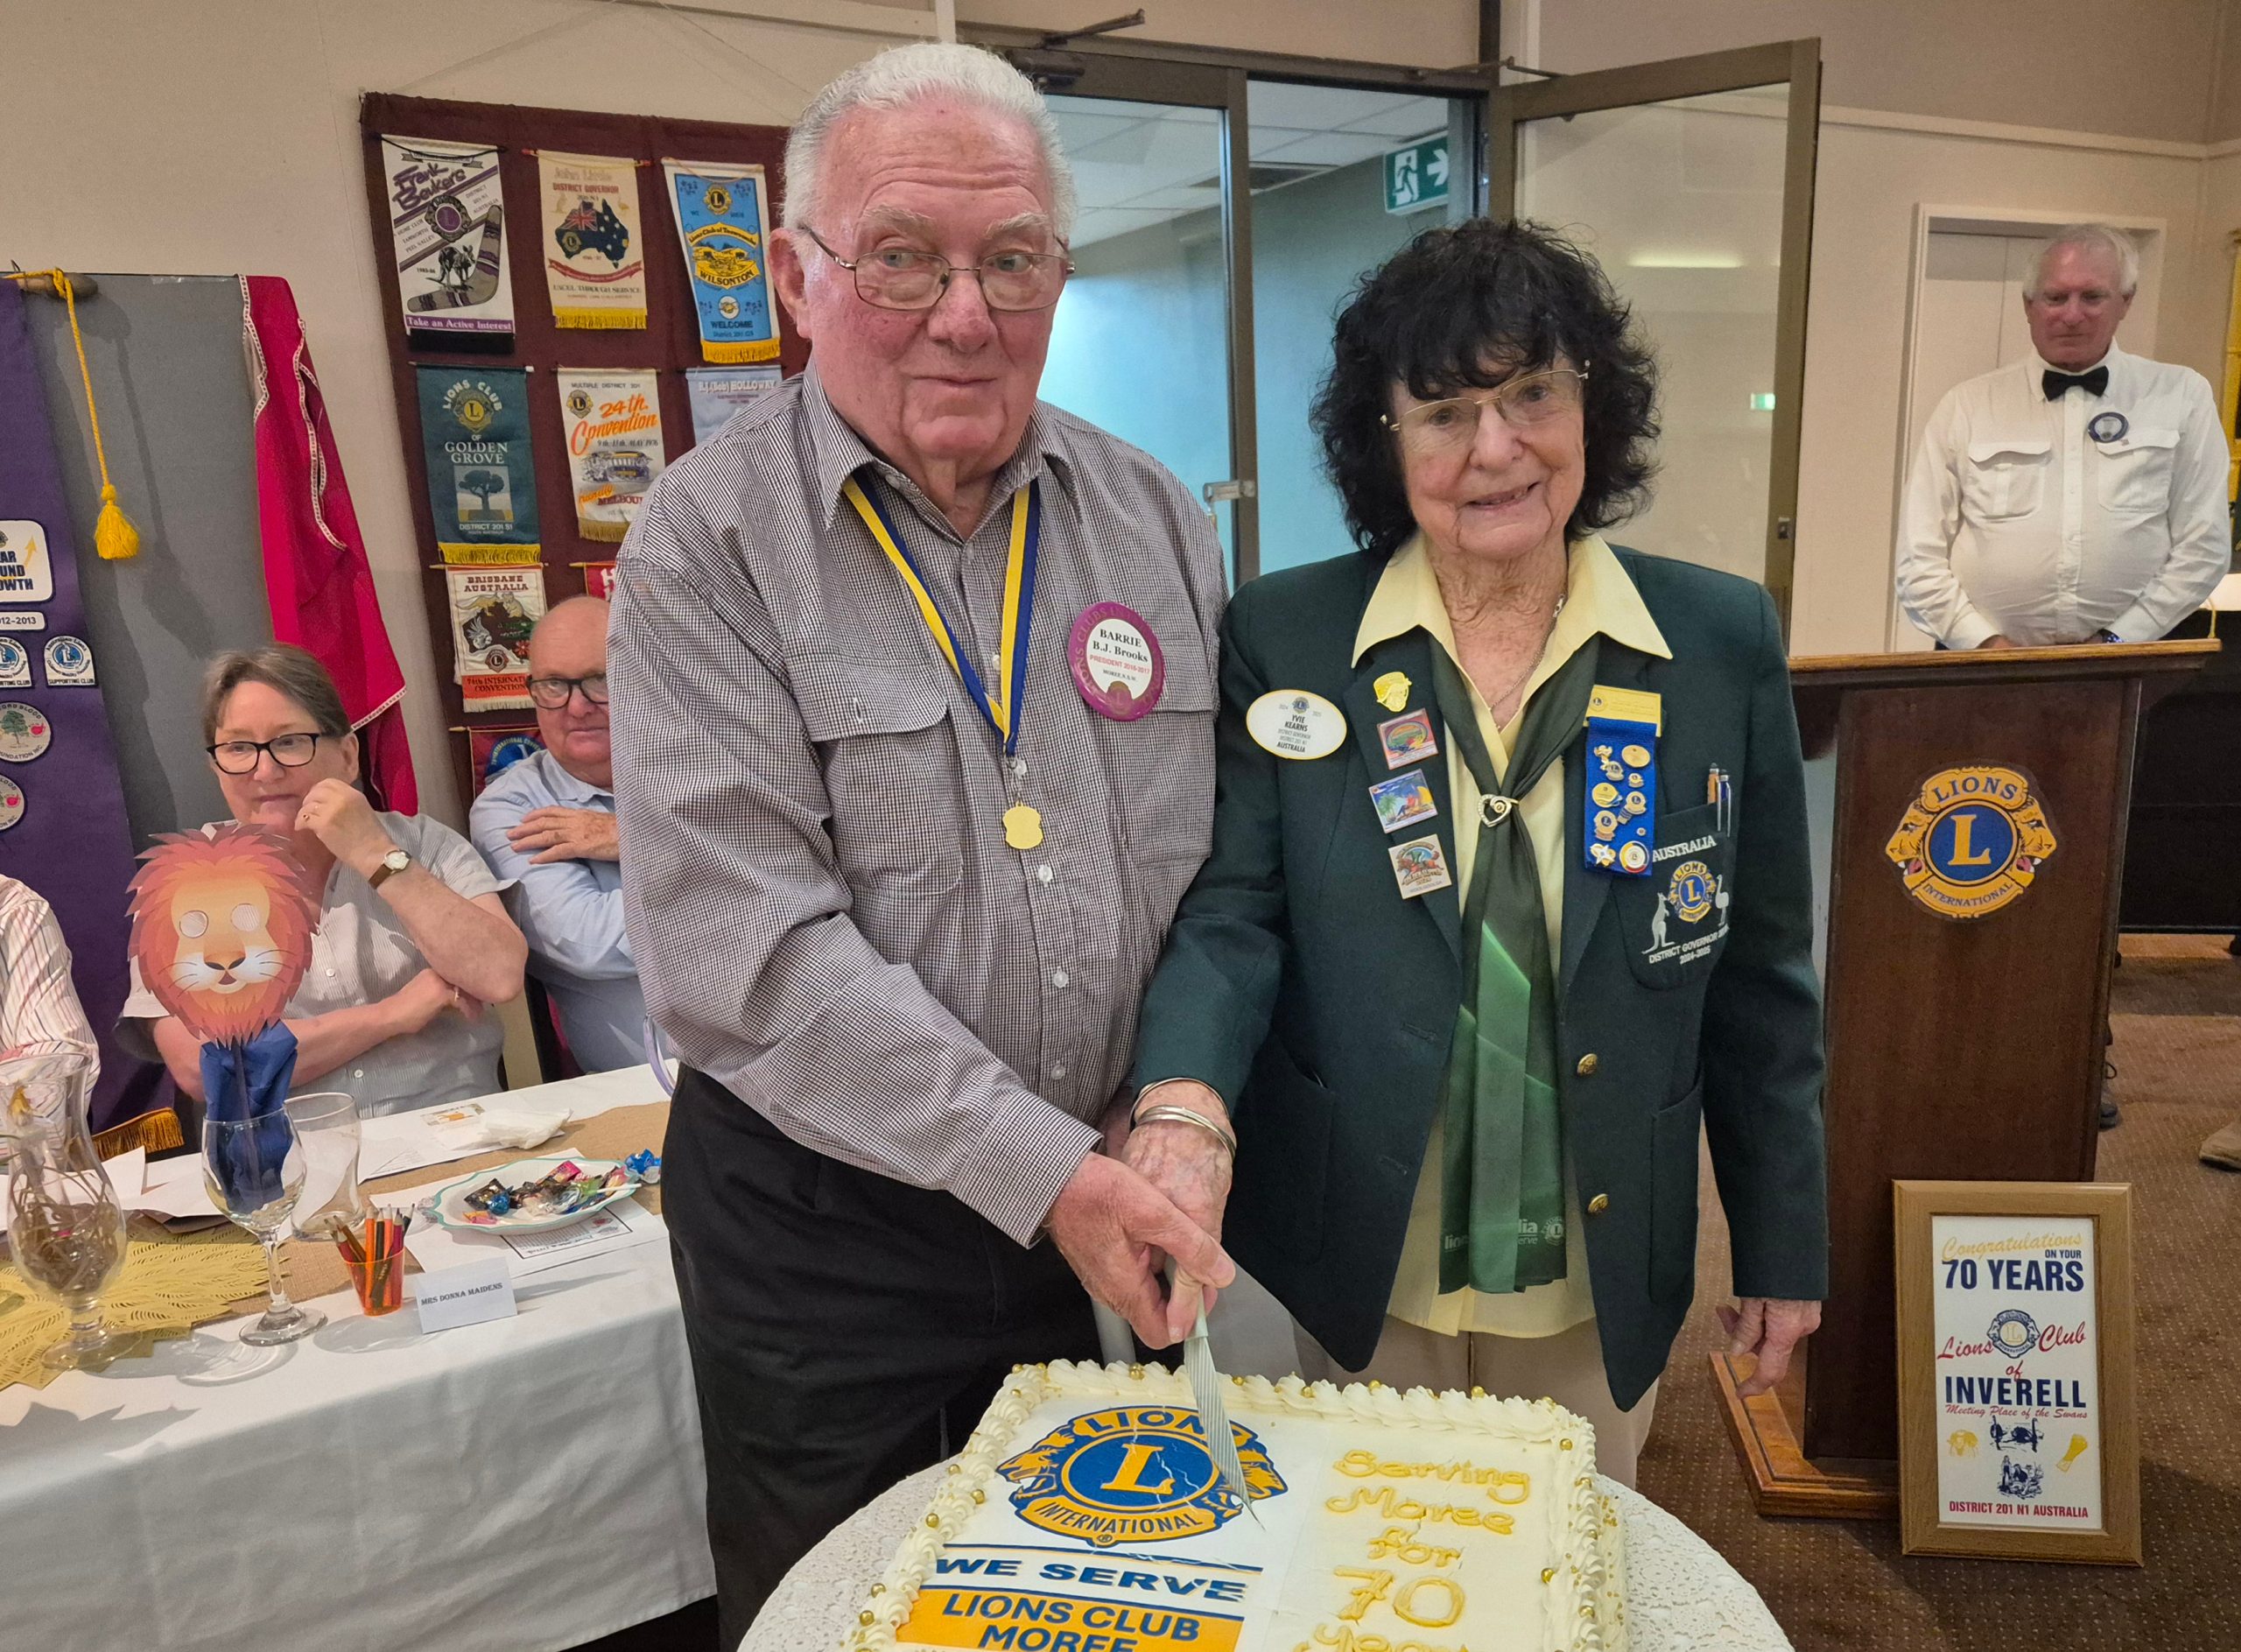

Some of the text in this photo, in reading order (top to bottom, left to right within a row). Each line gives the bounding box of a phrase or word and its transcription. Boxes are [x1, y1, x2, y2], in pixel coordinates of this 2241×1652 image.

[553, 183, 619, 193] DISTRICT GOVERNOR
[703, 227, 716, 235] Club
[700, 269, 754, 286] WILSONTON
[407, 317, 429, 327] Take
[446, 320, 474, 329] Active
[477, 321, 512, 330] Interest
[442, 379, 503, 411] LIONS CLUB
[730, 380, 776, 390] HOLLOWAY
[571, 411, 659, 456] Convention
[445, 441, 508, 453] GOLDEN
[451, 453, 505, 464] GROVE
[0, 565, 25, 577] UND
[1078, 606, 1107, 643] CLUBS
[73, 638, 88, 651] Lions
[1099, 629, 1142, 649] BARRIE
[1090, 655, 1123, 668] PRESIDENT
[1092, 641, 1149, 663] B.J. Brooks
[19, 704, 42, 720] BLOOD
[1292, 714, 1306, 723] YVIE
[1284, 721, 1308, 732] KEARNS
[1277, 742, 1306, 752] AUSTRALIA
[1932, 777, 2018, 803] LIONS
[1653, 835, 1718, 862] AUSTRALIA
[1947, 814, 1992, 866] L
[1675, 863, 1705, 879] LIONS
[1685, 879, 1702, 903] L
[1923, 882, 2013, 907] INTERNATIONAL
[1649, 931, 1718, 964] DISTRICT GOVERNOR
[1942, 1233, 2083, 1262] Congratulations
[2045, 1249, 2082, 1259] ON YOUR
[1942, 1259, 2084, 1292] 70 YEARS
[421, 1283, 503, 1305] MRS DONNA MAIDENS
[1936, 1321, 2086, 1360] Lions Club
[2006, 1360, 2024, 1382] of
[1945, 1376, 2086, 1408] INVERELL
[1945, 1404, 2088, 1419] Meeting Place of the Swans
[1086, 1409, 1208, 1438] LION
[1100, 1443, 1176, 1494] L
[1332, 1449, 1530, 1505] Serving
[1034, 1501, 1204, 1534] INTERNATIONAL
[1325, 1486, 1515, 1535] Moree
[1949, 1501, 2089, 1518] DISTRICT 201 N1 AUSTRALIA
[1366, 1526, 1463, 1567] for
[936, 1558, 1249, 1603] WE SERVE
[1333, 1564, 1466, 1627] 70
[942, 1593, 1200, 1641] LIONS CLUB
